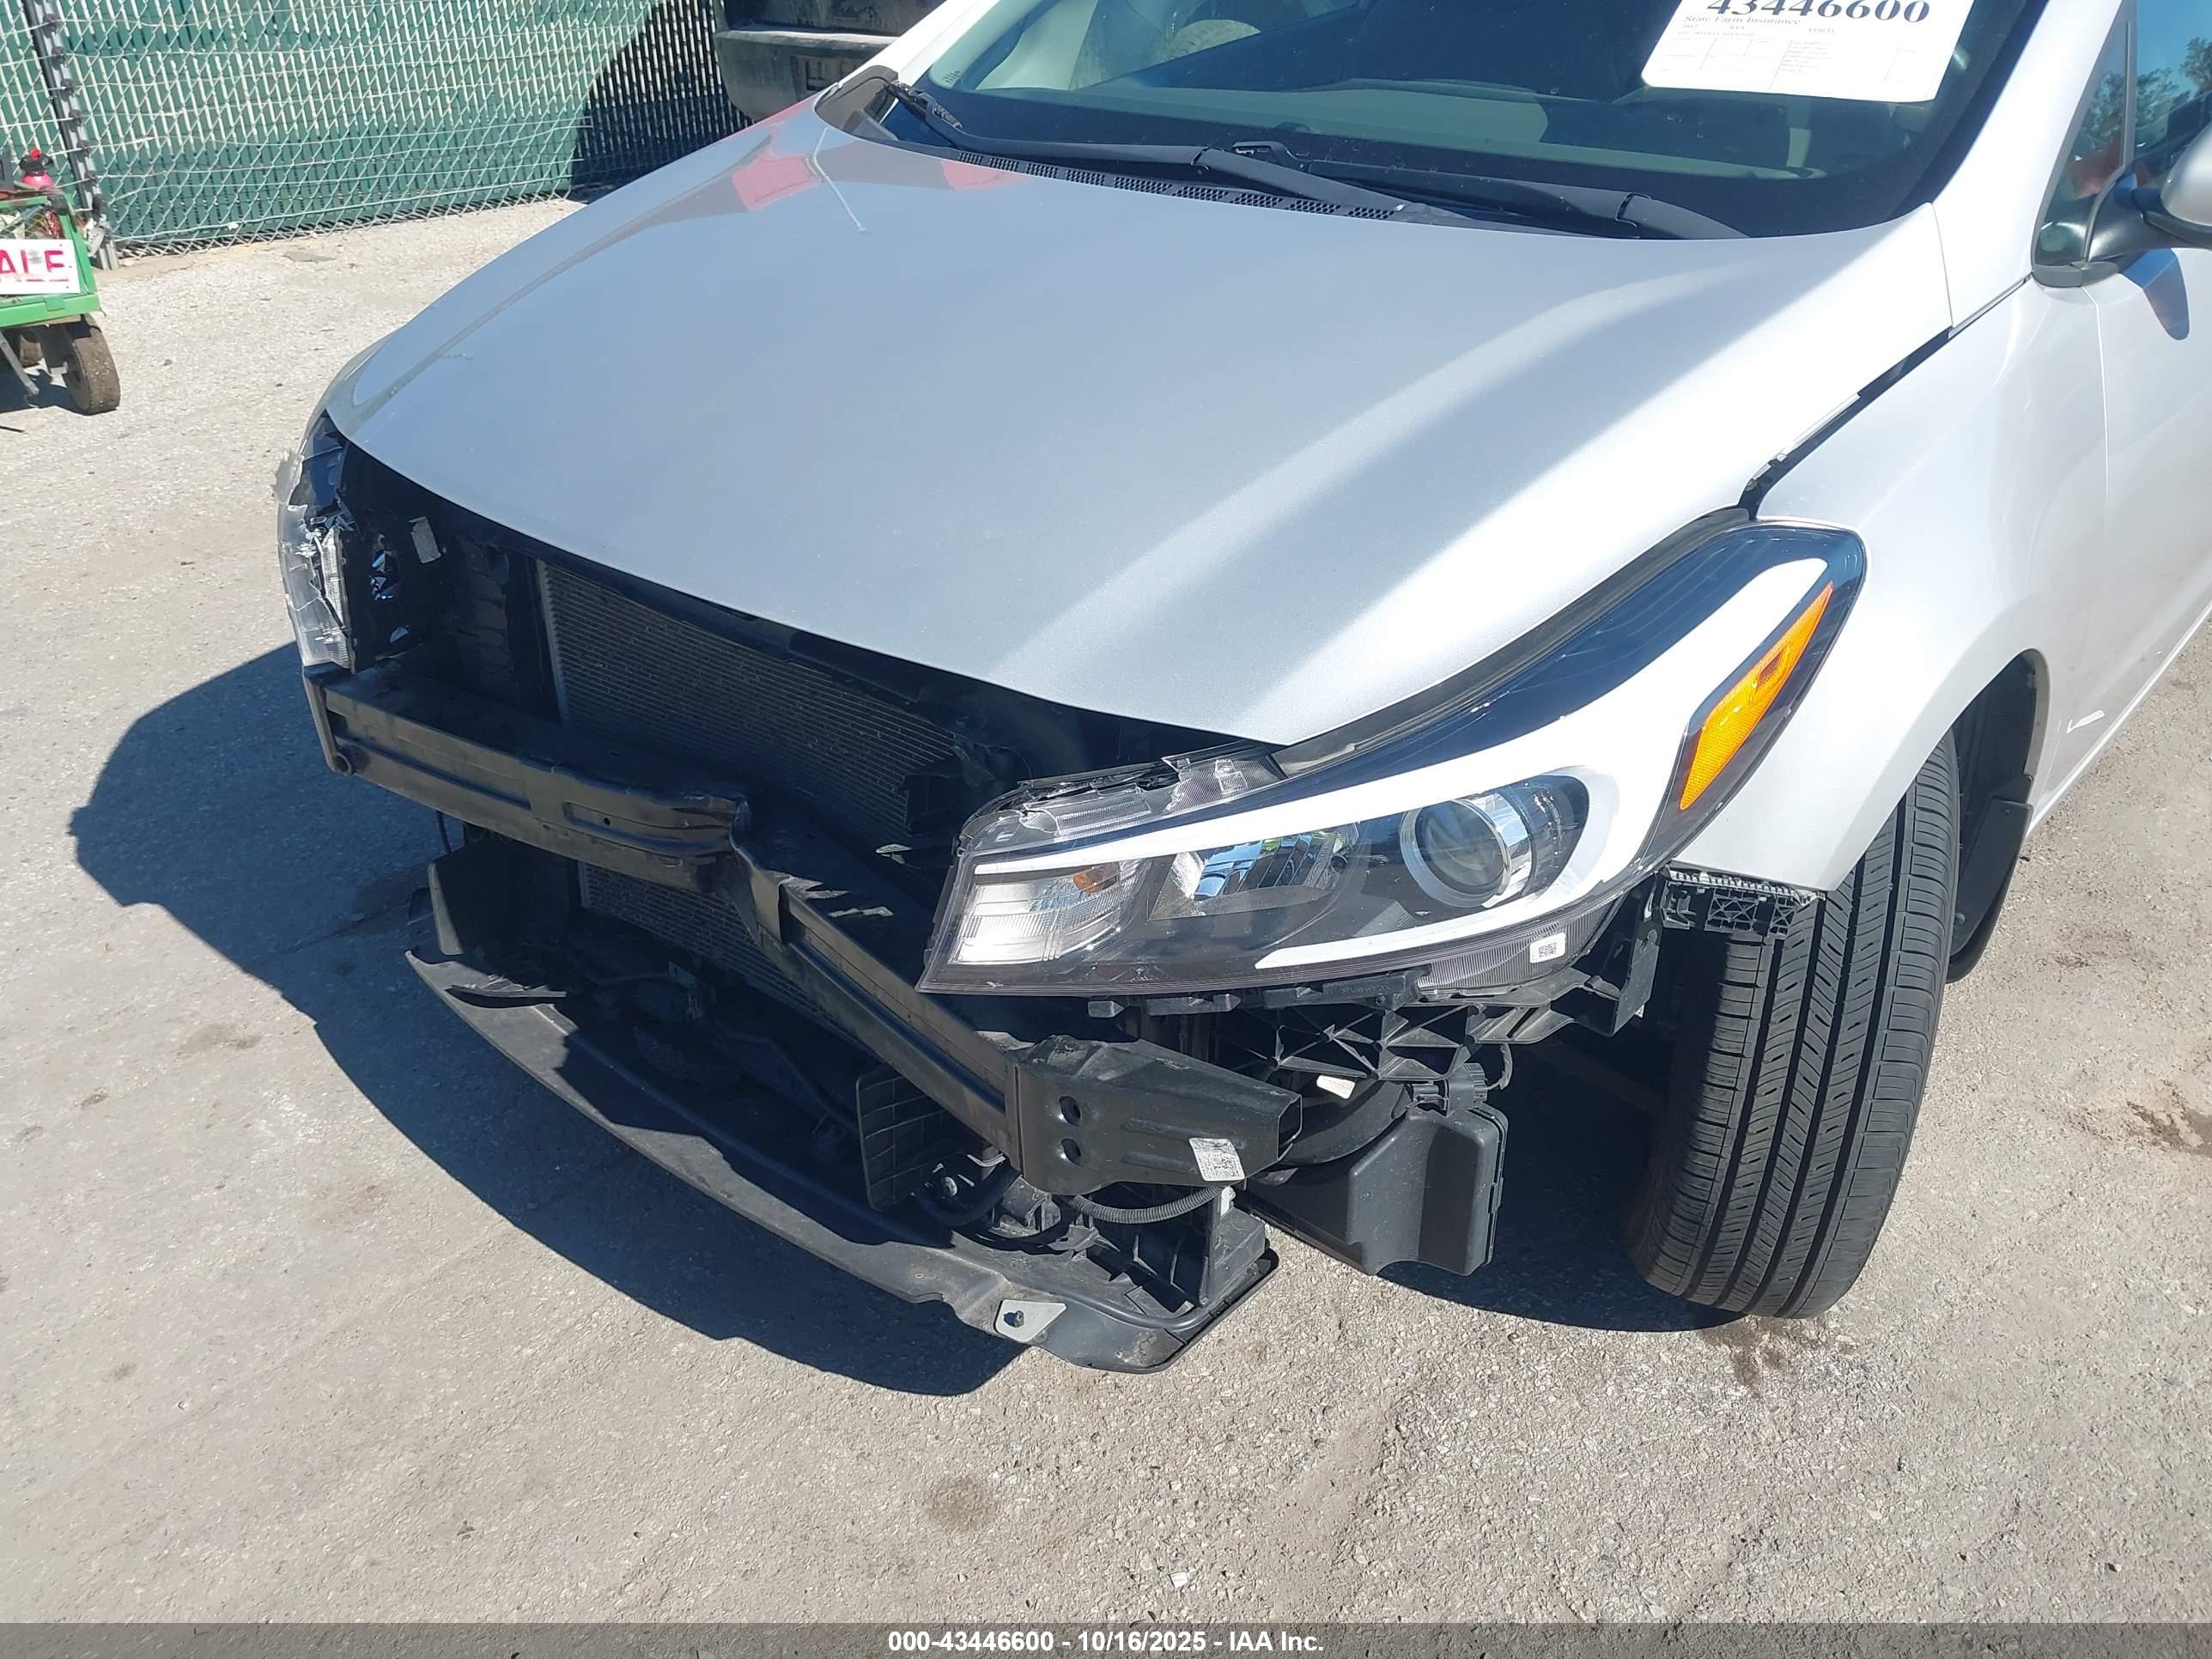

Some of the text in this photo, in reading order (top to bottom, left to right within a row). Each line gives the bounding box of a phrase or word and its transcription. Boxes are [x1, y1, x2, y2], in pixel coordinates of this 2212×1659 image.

[1707, 0, 1930, 22] 43446600
[1684, 15, 1801, 26] State Farm Insurance
